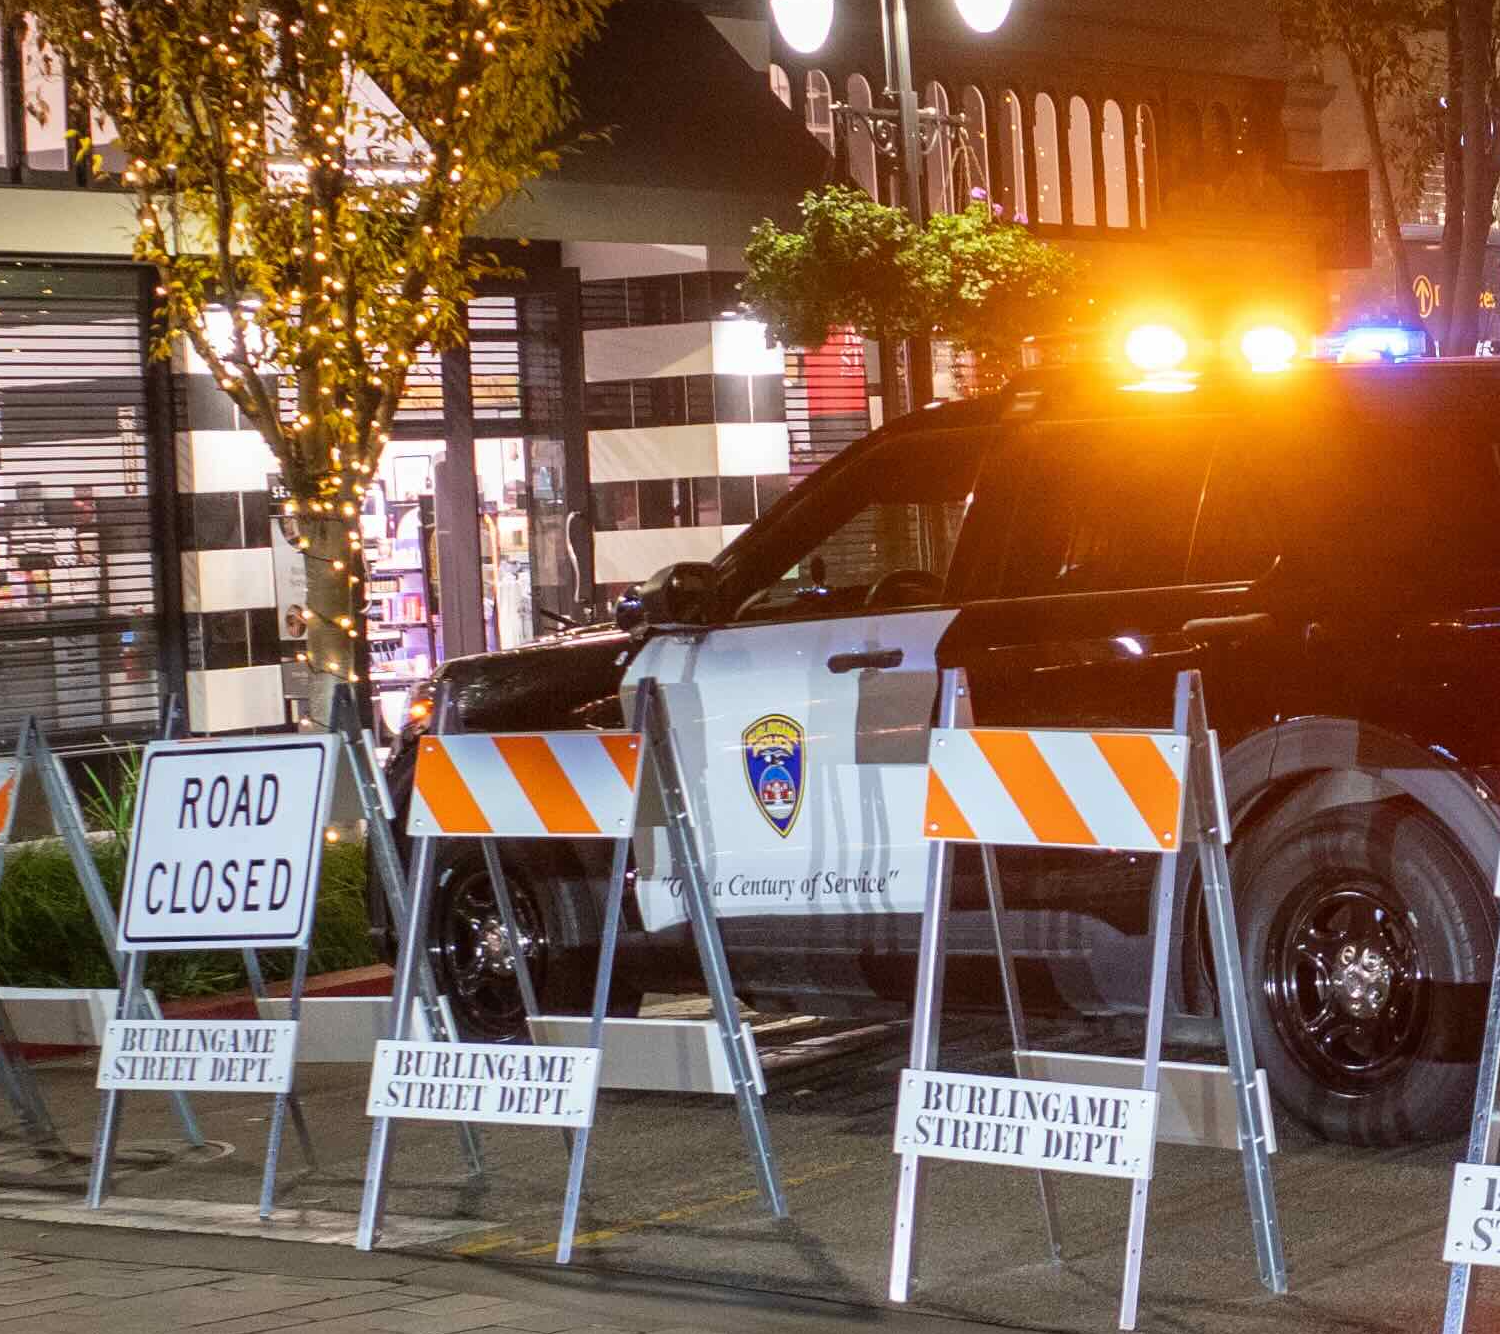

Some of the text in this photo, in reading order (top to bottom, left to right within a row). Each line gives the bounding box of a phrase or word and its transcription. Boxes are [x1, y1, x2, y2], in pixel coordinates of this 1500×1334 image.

[179, 773, 280, 829] ROAD
[146, 859, 292, 914] CLOSED
[713, 881, 723, 896] a
[728, 874, 795, 901] Century
[801, 871, 823, 901] of
[120, 1027, 277, 1053] BURLINGAME
[112, 1055, 273, 1083] STREET DEPT.
[393, 1050, 575, 1083] BURLINGAME
[386, 1081, 571, 1116] STREET DEPT.
[922, 1080, 1130, 1129] BURLINGAME
[914, 1115, 1127, 1166] STREET DEPT.
